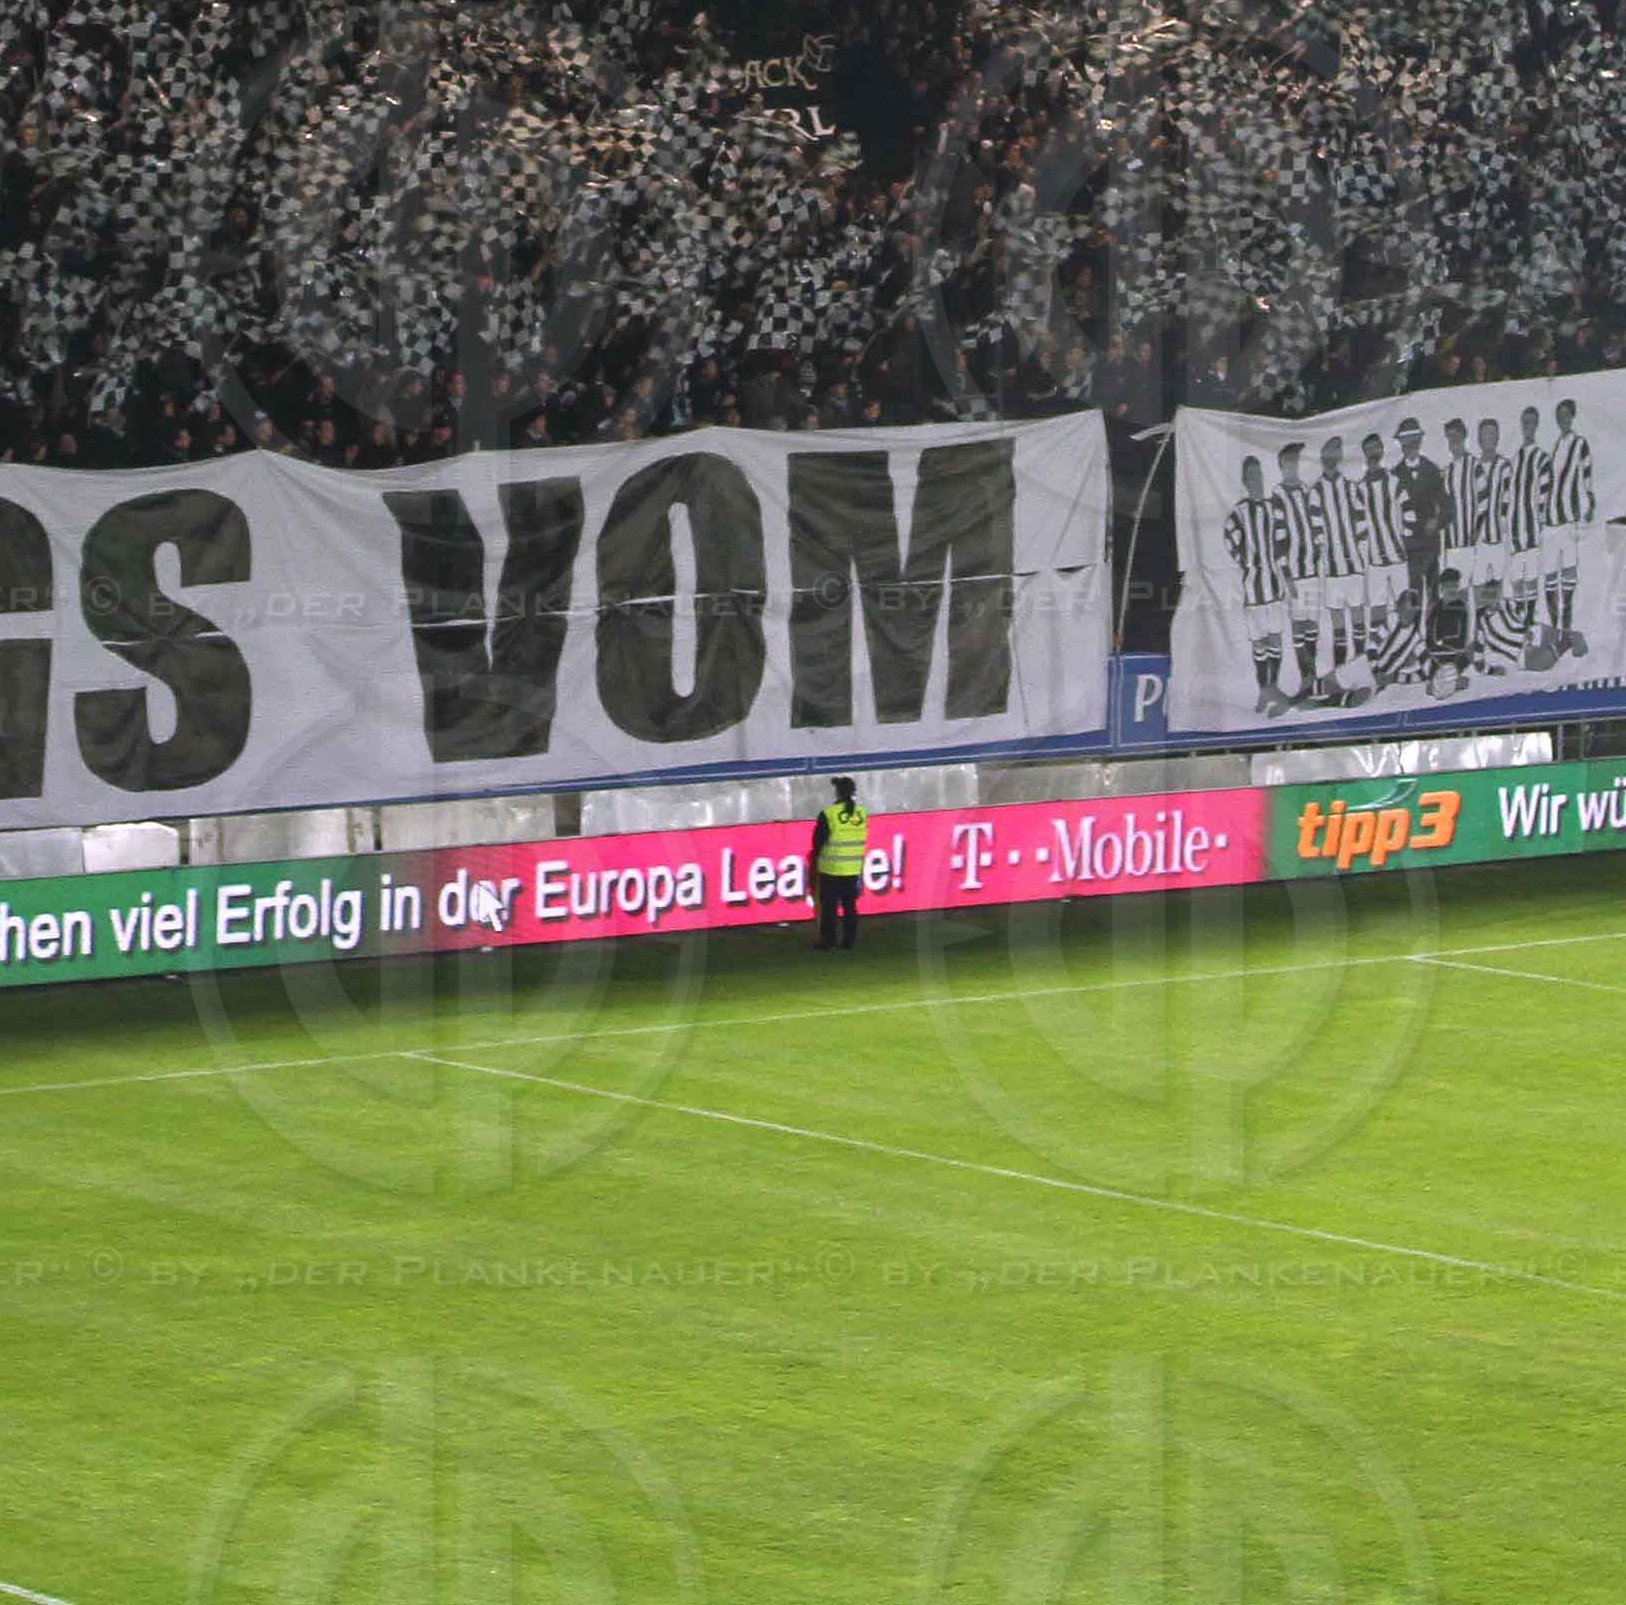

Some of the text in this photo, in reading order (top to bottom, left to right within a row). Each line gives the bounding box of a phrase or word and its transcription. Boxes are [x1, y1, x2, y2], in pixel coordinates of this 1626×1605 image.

[383, 438, 1017, 763] VOM
[1296, 790, 1461, 871] tipp3
[1497, 784, 1568, 837] Wir
[109, 887, 199, 953] viel
[216, 877, 363, 950] Erfolg
[379, 874, 422, 932] in
[535, 859, 704, 922] Europa
[721, 834, 905, 907] Leae!
